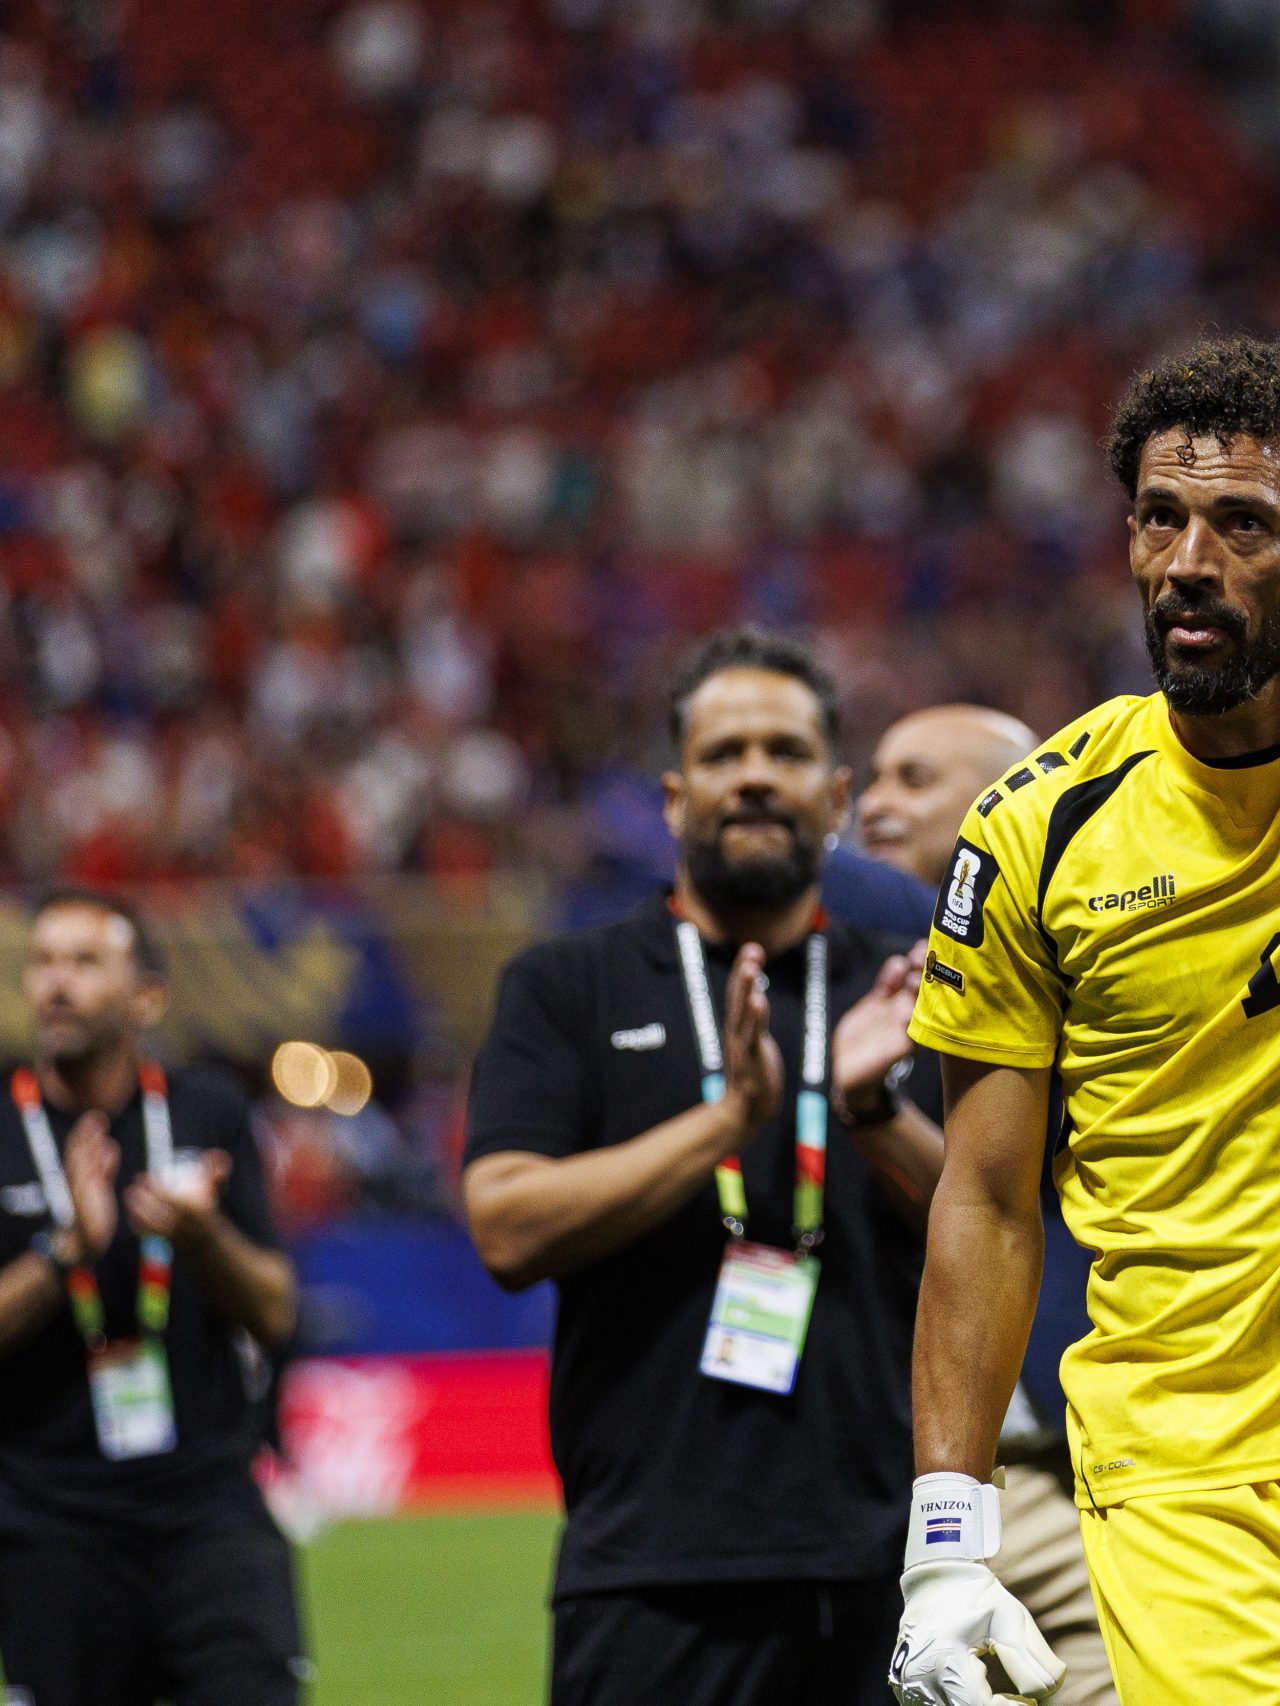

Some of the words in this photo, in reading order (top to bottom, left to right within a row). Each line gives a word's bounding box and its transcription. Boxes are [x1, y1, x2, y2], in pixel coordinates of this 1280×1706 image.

[1088, 873, 1175, 911] capelli
[1128, 896, 1176, 912] SPORT
[941, 915, 968, 936] 2026
[920, 1500, 973, 1513] VOZINHA
